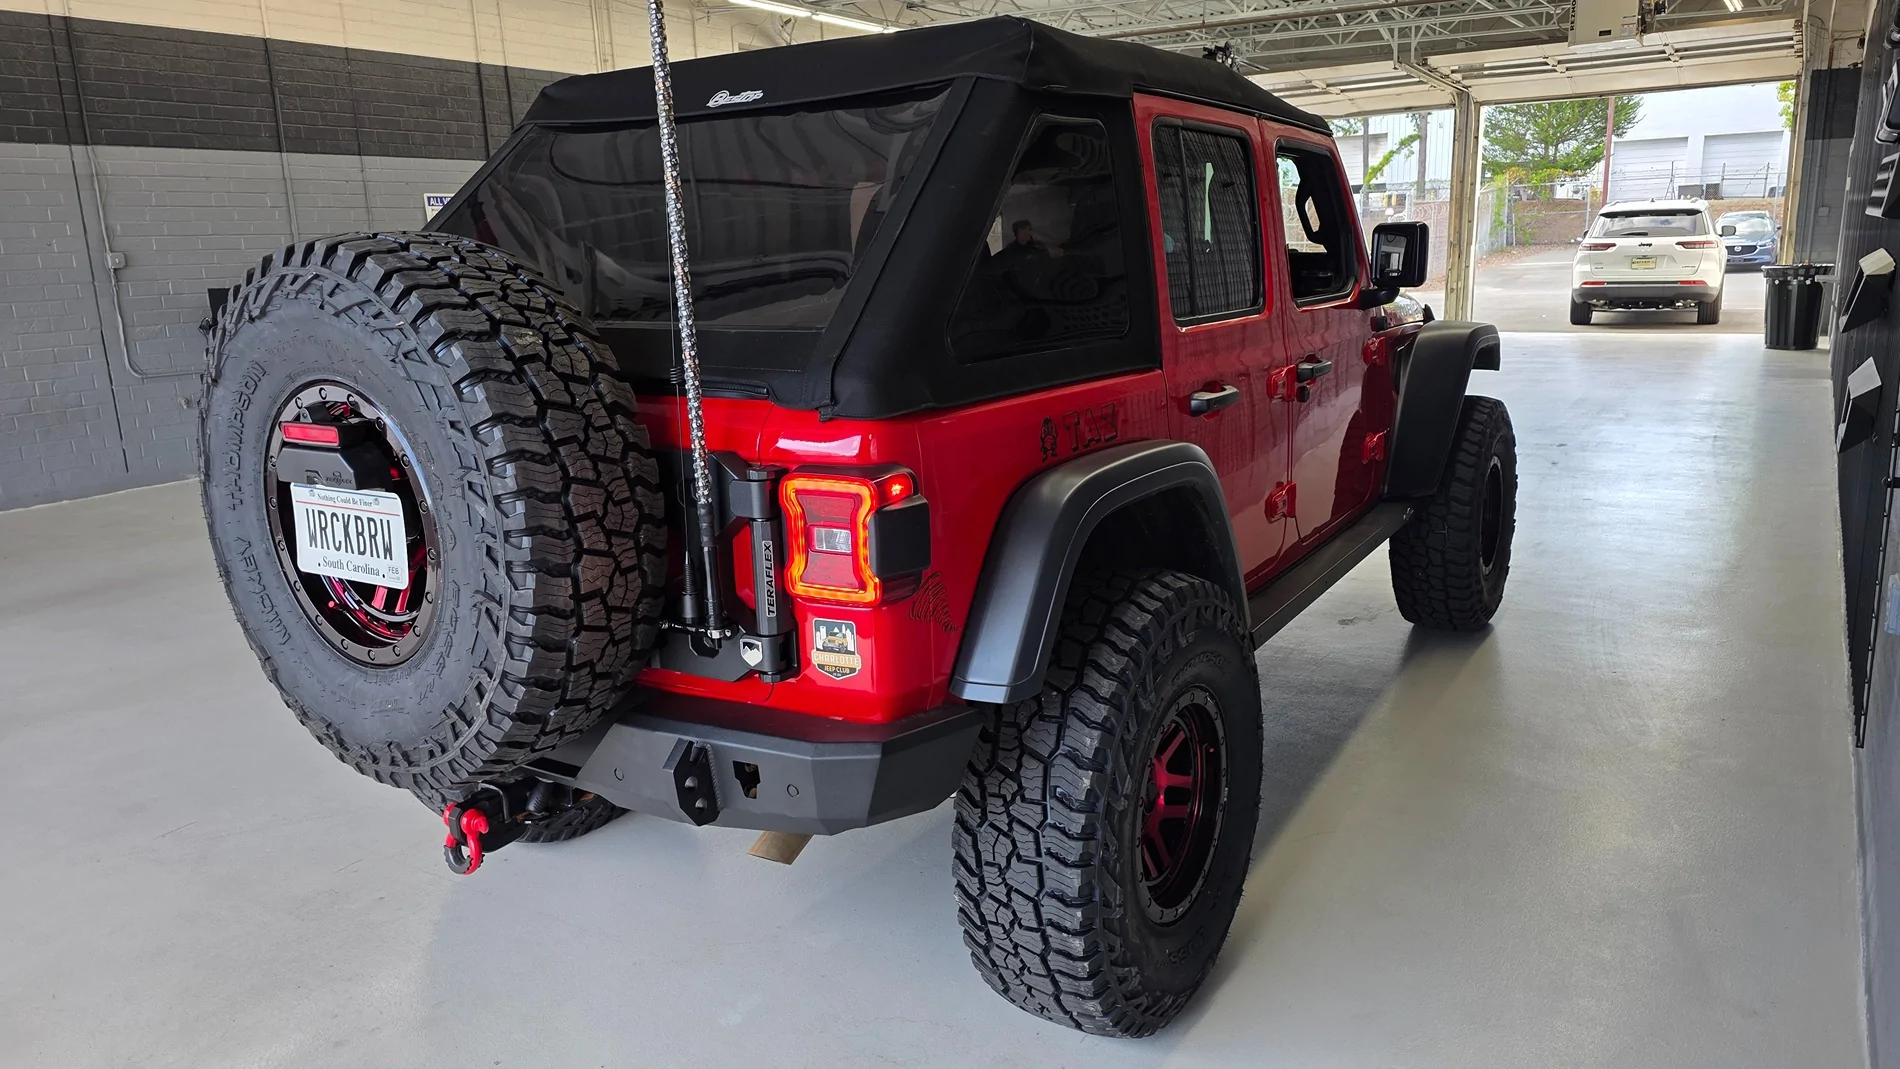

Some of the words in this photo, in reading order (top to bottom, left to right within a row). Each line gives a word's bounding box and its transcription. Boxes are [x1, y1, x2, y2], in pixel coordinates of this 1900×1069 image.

[430, 197, 443, 206] ALL
[226, 360, 267, 511] THOMPSON
[1062, 402, 1118, 452] TAZ
[317, 493, 336, 504] Nothing
[337, 495, 351, 505] Could
[352, 497, 359, 506] Be
[360, 498, 373, 507] Finer
[305, 508, 393, 561] WRCKBRW
[322, 555, 345, 570] South
[346, 560, 380, 577] Carolina
[388, 566, 400, 575] FEB
[764, 543, 775, 616] TERAFLEX
[232, 536, 292, 646] MICKEY
[813, 652, 859, 666] CHARLOTTE
